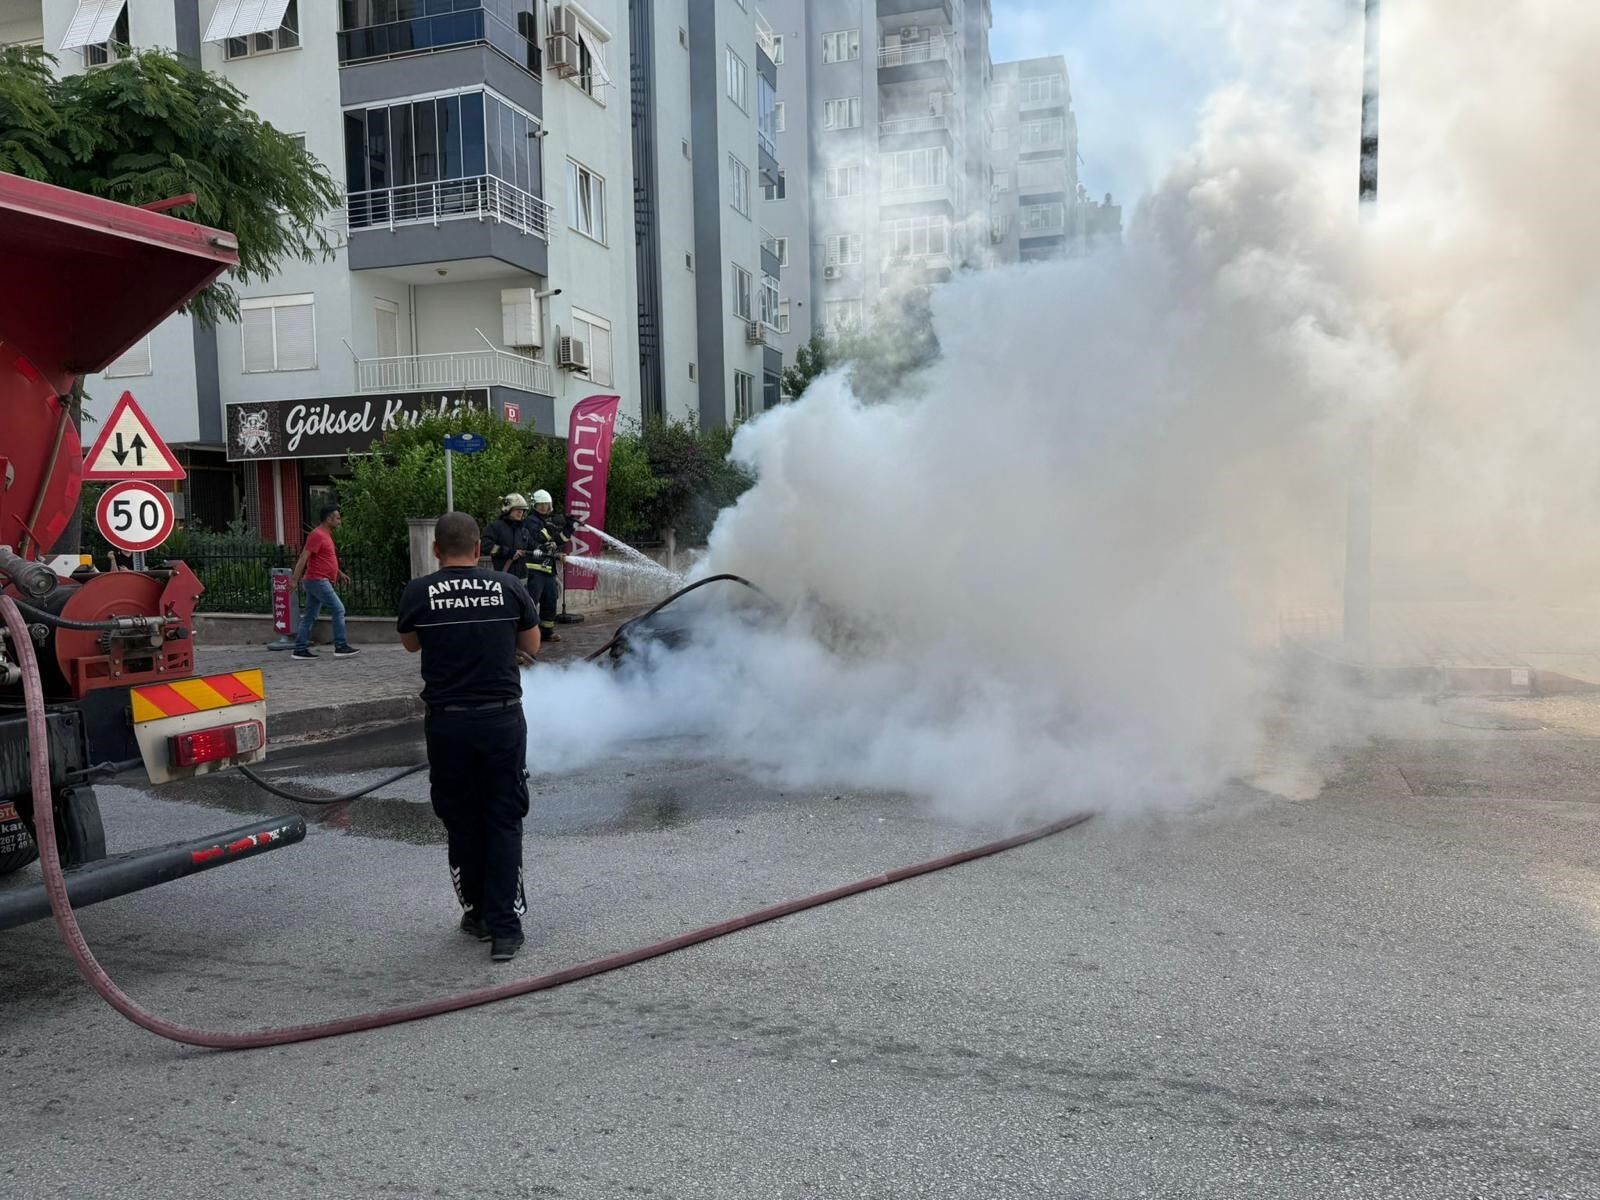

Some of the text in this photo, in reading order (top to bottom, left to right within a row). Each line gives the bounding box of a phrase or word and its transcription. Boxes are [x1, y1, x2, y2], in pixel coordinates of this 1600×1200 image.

[285, 401, 376, 452] Göksel
[112, 500, 159, 532] 50
[427, 578, 503, 598] ANTALYA
[430, 594, 504, 611] İTFAİYESİ
